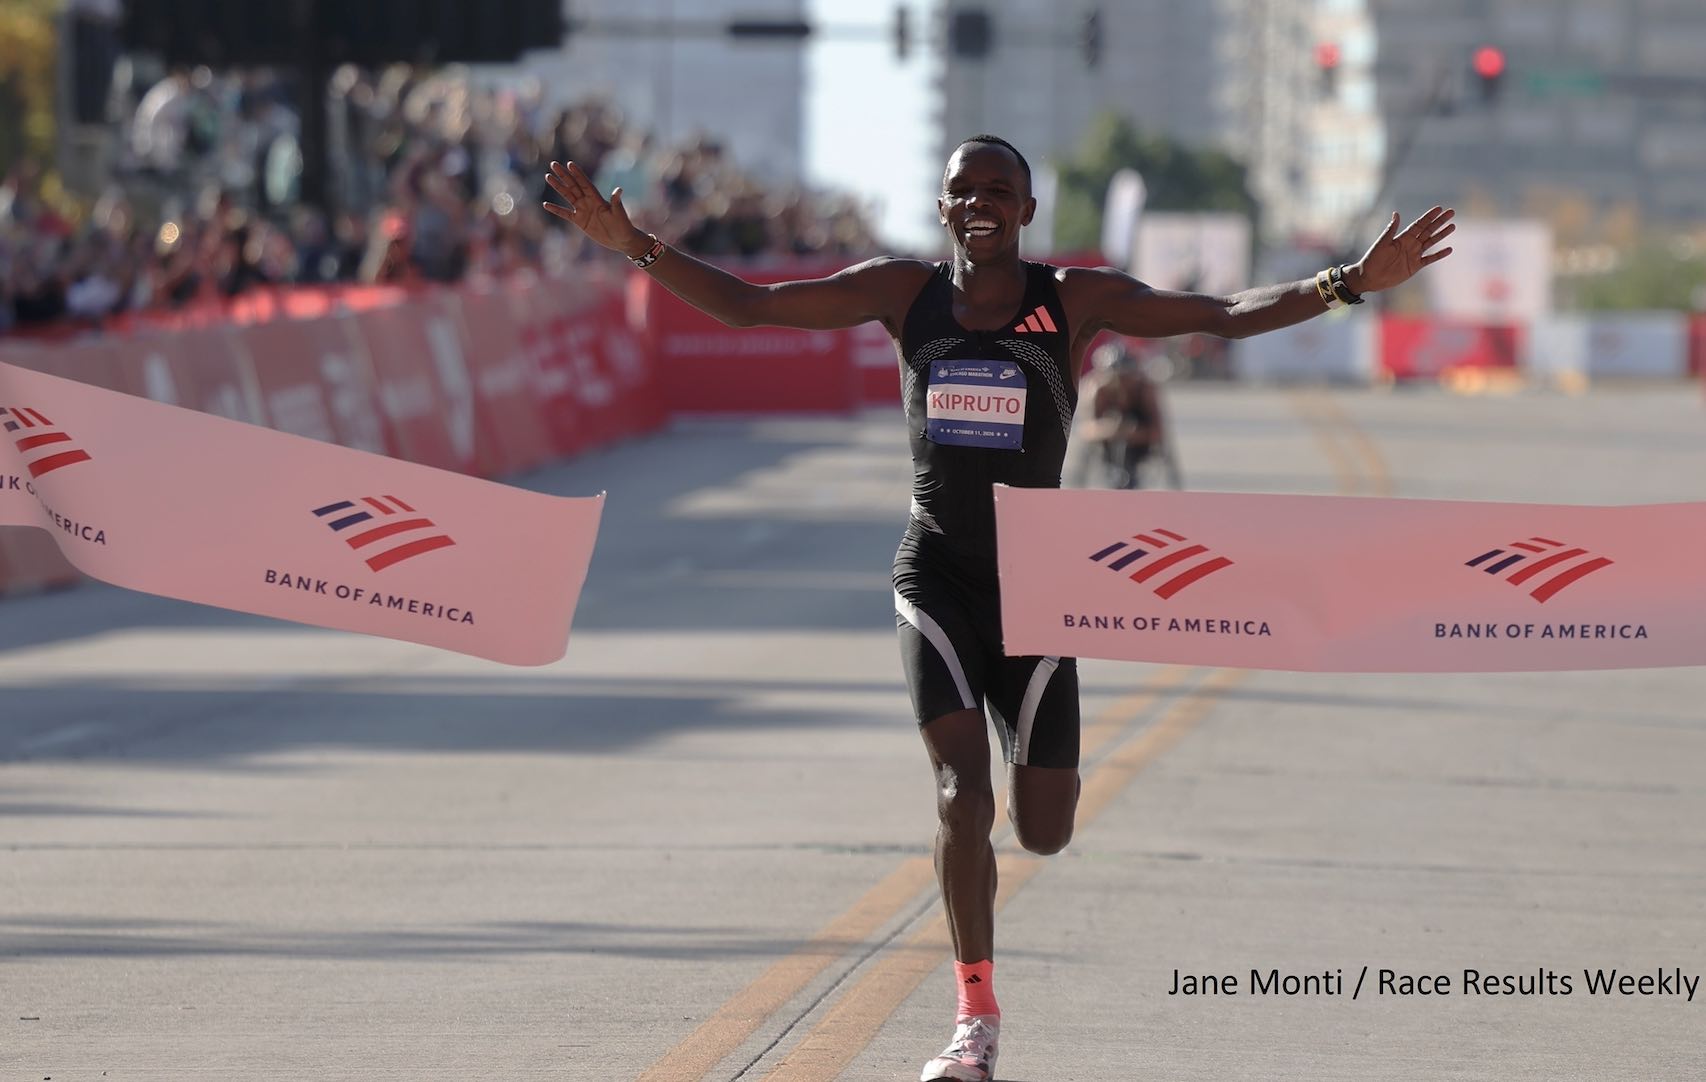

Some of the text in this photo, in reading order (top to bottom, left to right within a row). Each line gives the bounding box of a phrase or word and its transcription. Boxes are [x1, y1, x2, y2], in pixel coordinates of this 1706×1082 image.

[932, 393, 1020, 414] KIPRUTO
[265, 569, 475, 625] BANK OF AMERICA
[1063, 614, 1272, 636] BANK OF AMERICA
[1434, 623, 1649, 640] BANK OF AMERICA
